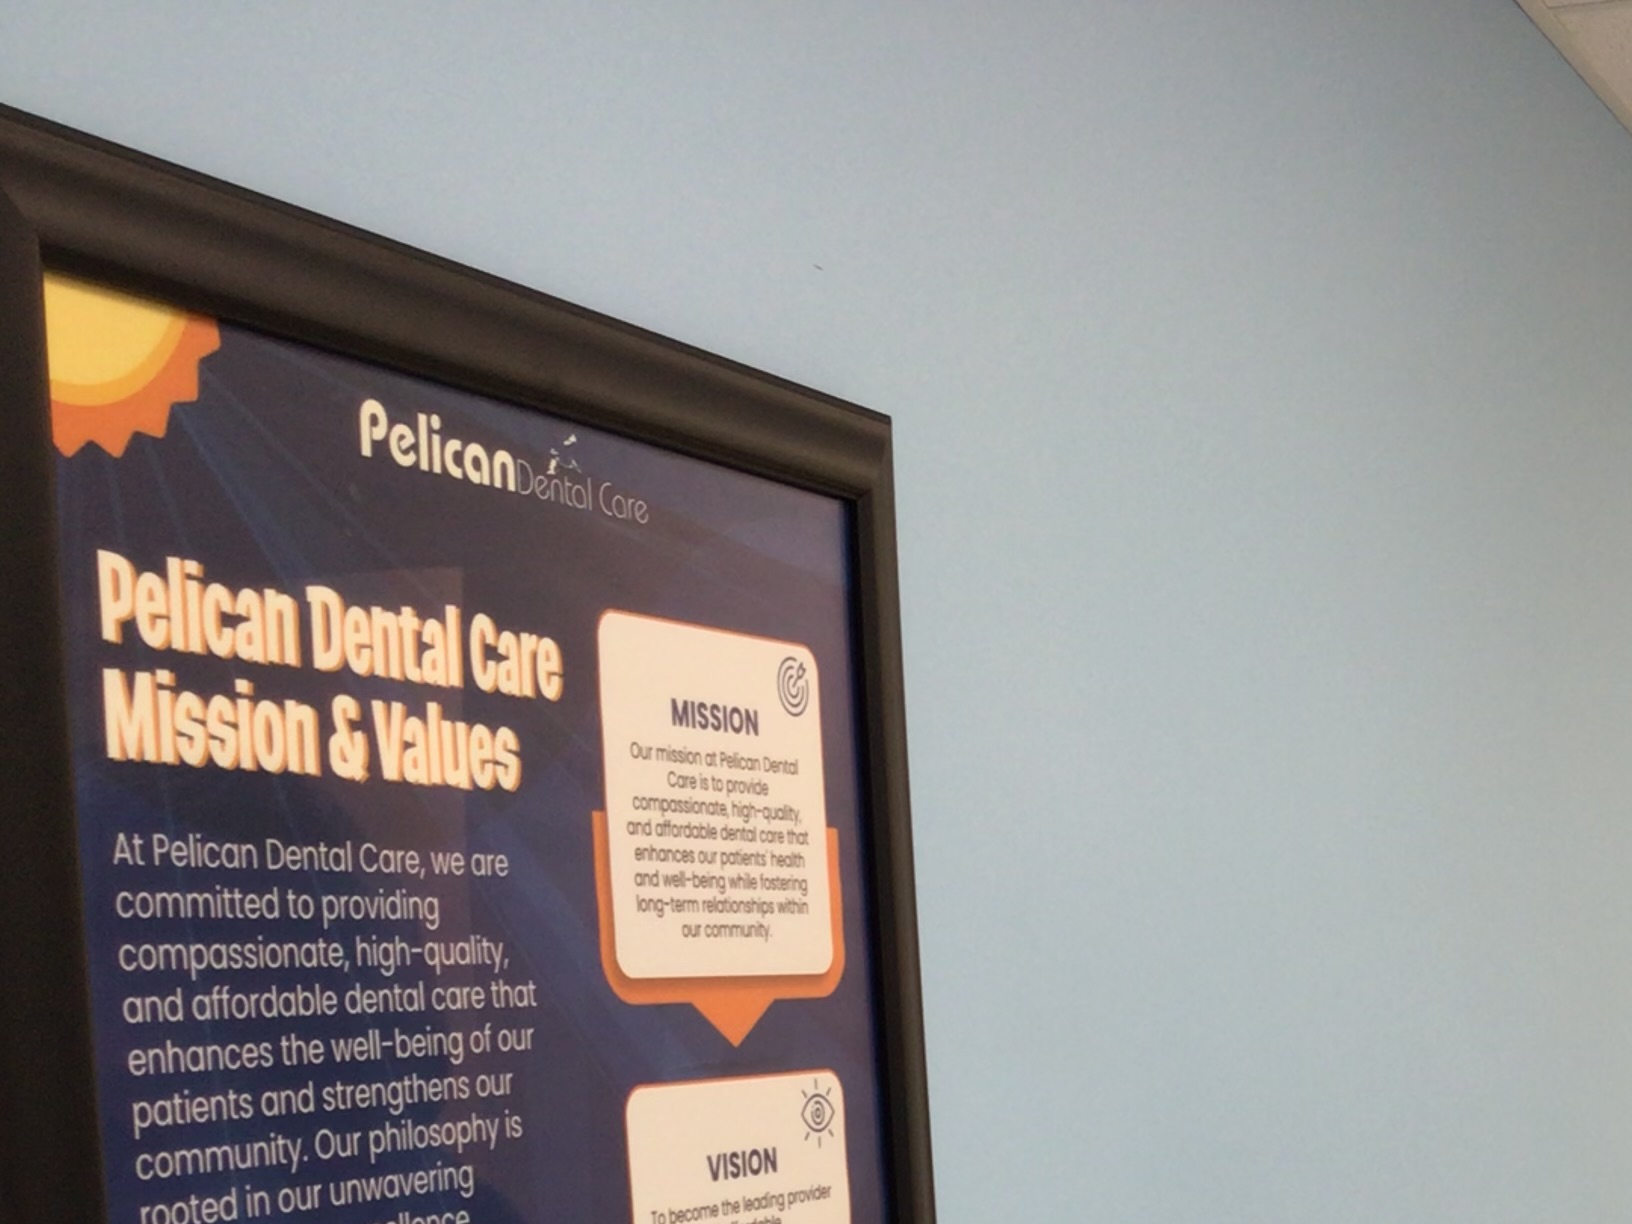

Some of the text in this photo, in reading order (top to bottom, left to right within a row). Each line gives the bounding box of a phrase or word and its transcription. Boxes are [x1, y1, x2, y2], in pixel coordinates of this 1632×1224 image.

[599, 482, 649, 524] Care
[98, 549, 563, 701] Pelican Dental Care
[103, 668, 521, 792] Mission & Values
[671, 698, 758, 736] MISSION
[630, 742, 798, 775] Our mission at Pelican Dental
[668, 771, 768, 796] Care is to provide
[627, 820, 808, 845] and affordable dental care that
[113, 833, 508, 879] At Pelican Dental Care, we are
[635, 846, 695, 863] enhances
[698, 852, 717, 864] our
[771, 851, 805, 868] health
[635, 870, 807, 897] and well-being while fostering
[116, 886, 439, 929] committed to providing
[636, 894, 808, 918] long-term relationships within
[682, 923, 702, 937] our
[119, 935, 508, 980] compassionate, high-quality,
[123, 980, 537, 1023] and affordable dental care that
[128, 1024, 534, 1076] enhances the well-being of our
[133, 1070, 512, 1139] patients and strengthens our
[136, 1111, 522, 1180] community. Our philosophy is
[707, 1148, 778, 1182] VISION
[246, 1186, 270, 1217] in
[278, 1184, 321, 1214] our
[329, 1161, 474, 1206] unwavering
[669, 1204, 719, 1224] become
[722, 1199, 741, 1217] the
[743, 1193, 784, 1212] leading
[788, 1185, 831, 1205] provider
